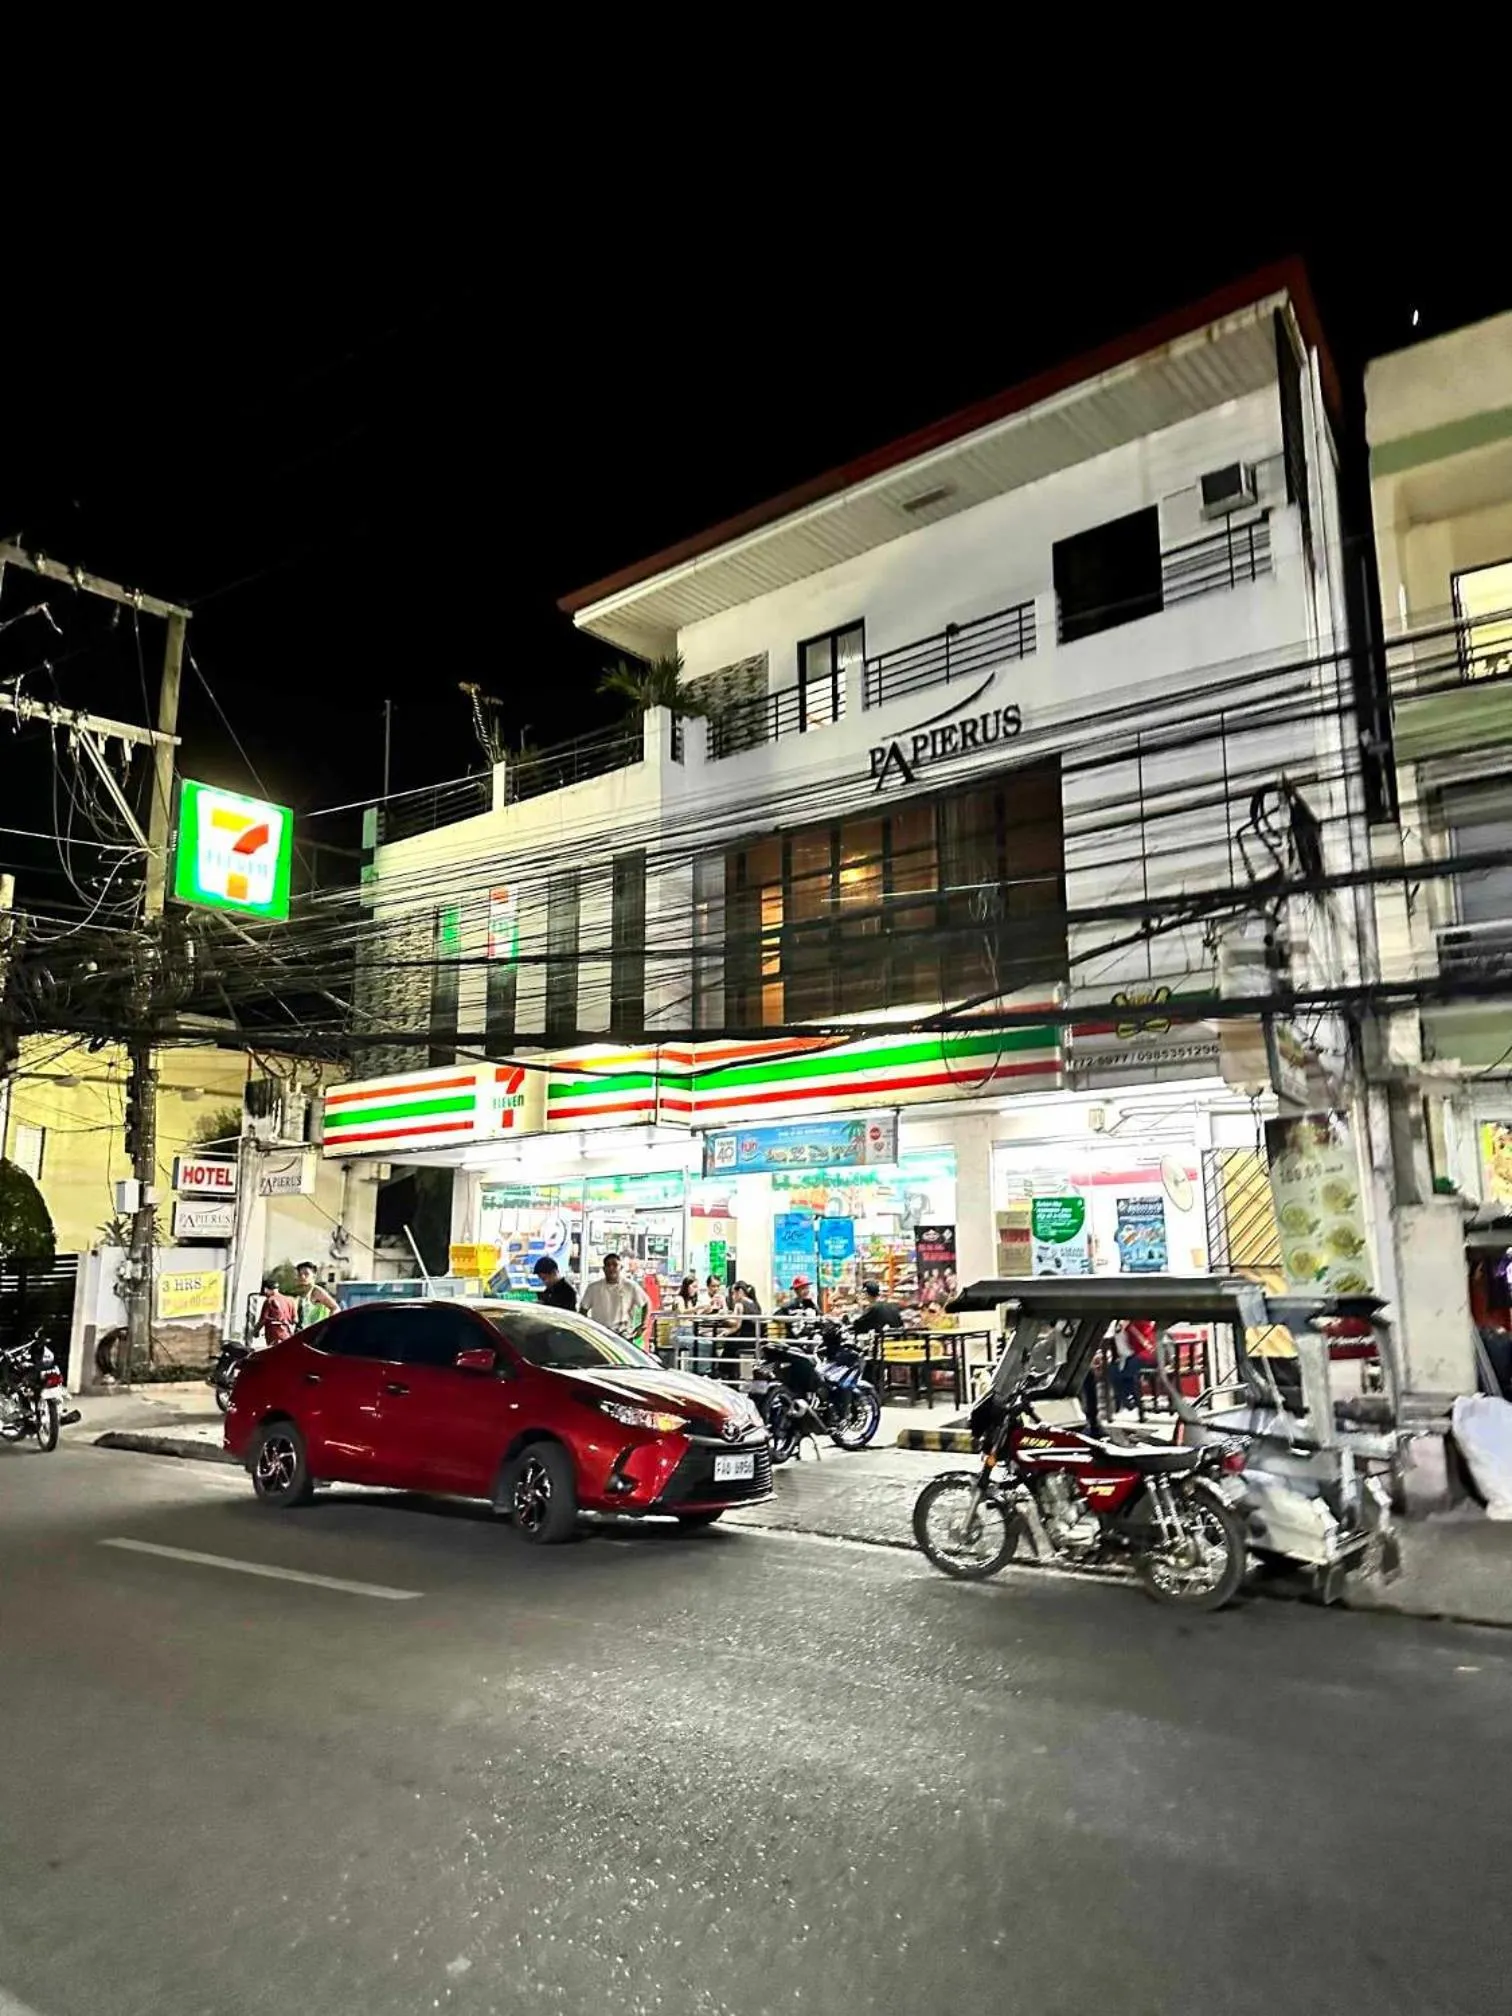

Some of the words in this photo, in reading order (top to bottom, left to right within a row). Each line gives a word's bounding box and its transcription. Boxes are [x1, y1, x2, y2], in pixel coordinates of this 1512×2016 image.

[869, 703, 1022, 792] PAPIERUS
[495, 1066, 525, 1128] 7
[183, 1165, 233, 1187] HOTEL
[260, 1175, 302, 1195] PAPIERUS
[181, 1212, 231, 1228] PAPIERUS
